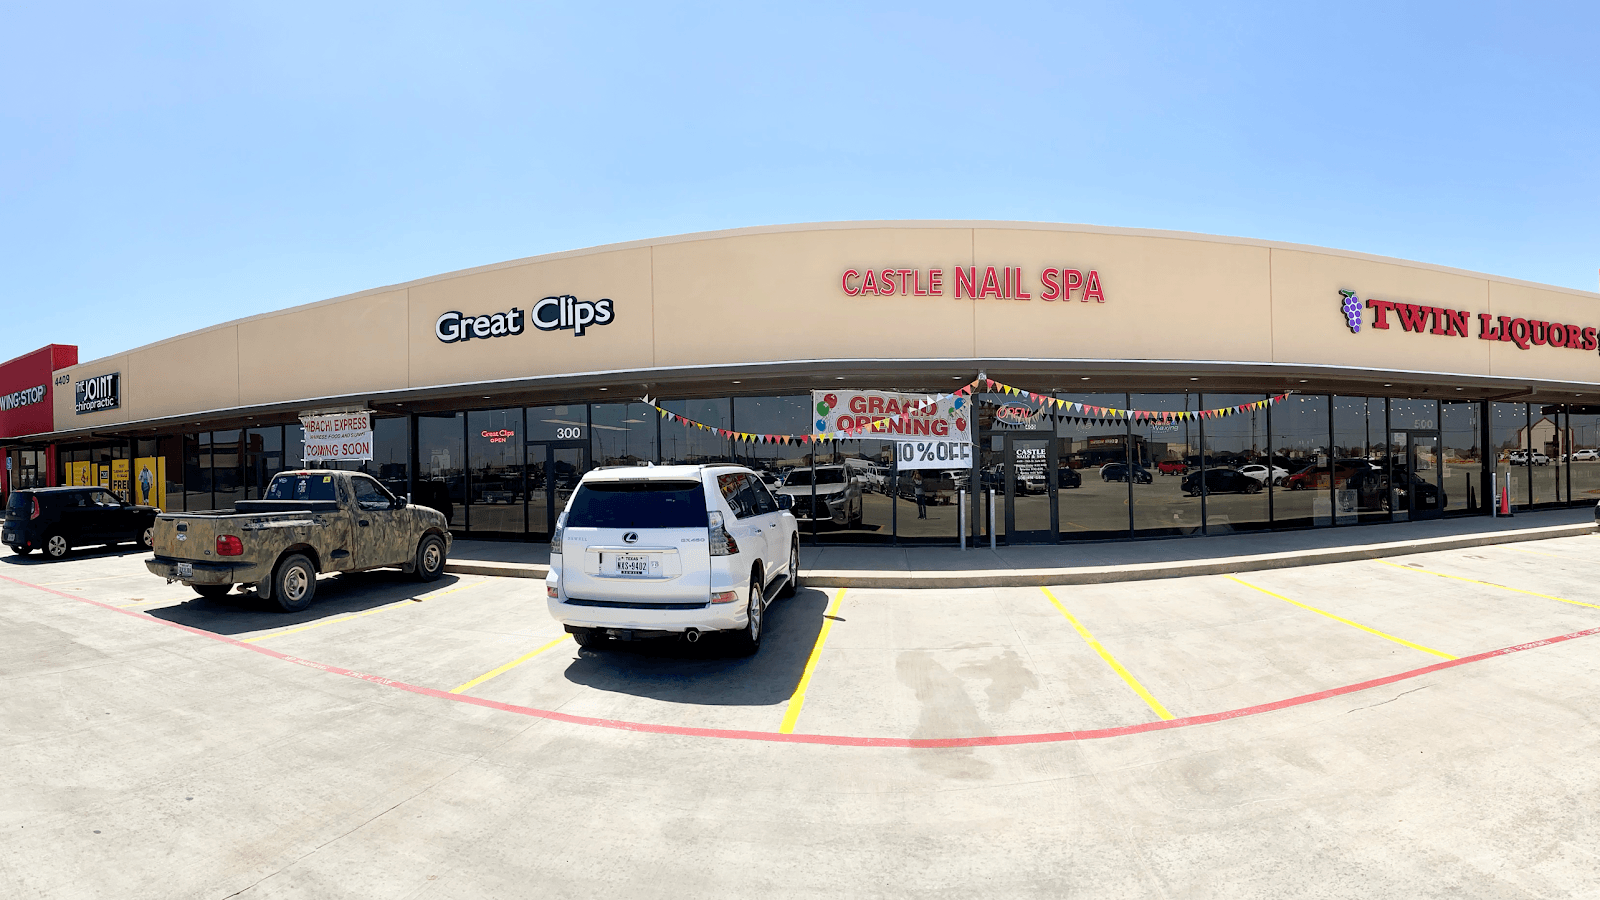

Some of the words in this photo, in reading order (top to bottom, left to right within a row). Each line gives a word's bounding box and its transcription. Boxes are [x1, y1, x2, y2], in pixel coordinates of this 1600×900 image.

[841, 269, 943, 296] CASTLE
[954, 266, 1032, 300] NAIL
[1040, 267, 1106, 303] SPA
[435, 308, 524, 343] Great
[532, 295, 615, 337] Clips
[1366, 298, 1470, 338] TWIN
[1478, 313, 1598, 350] LIQUORS
[55, 374, 70, 387] 4409
[84, 375, 113, 401] JOINT
[75, 397, 115, 412] chiropractic
[850, 396, 938, 416] GRAND
[997, 407, 1030, 419] OPEN
[304, 420, 333, 432] HIBACHI
[334, 417, 367, 431] EXPRESS
[836, 415, 949, 436] OPENING
[1413, 419, 1433, 429] 500
[481, 430, 498, 438] Great
[499, 429, 515, 438] Clips
[556, 427, 581, 439] 300
[306, 444, 339, 456] COMING
[341, 441, 370, 455] SOON
